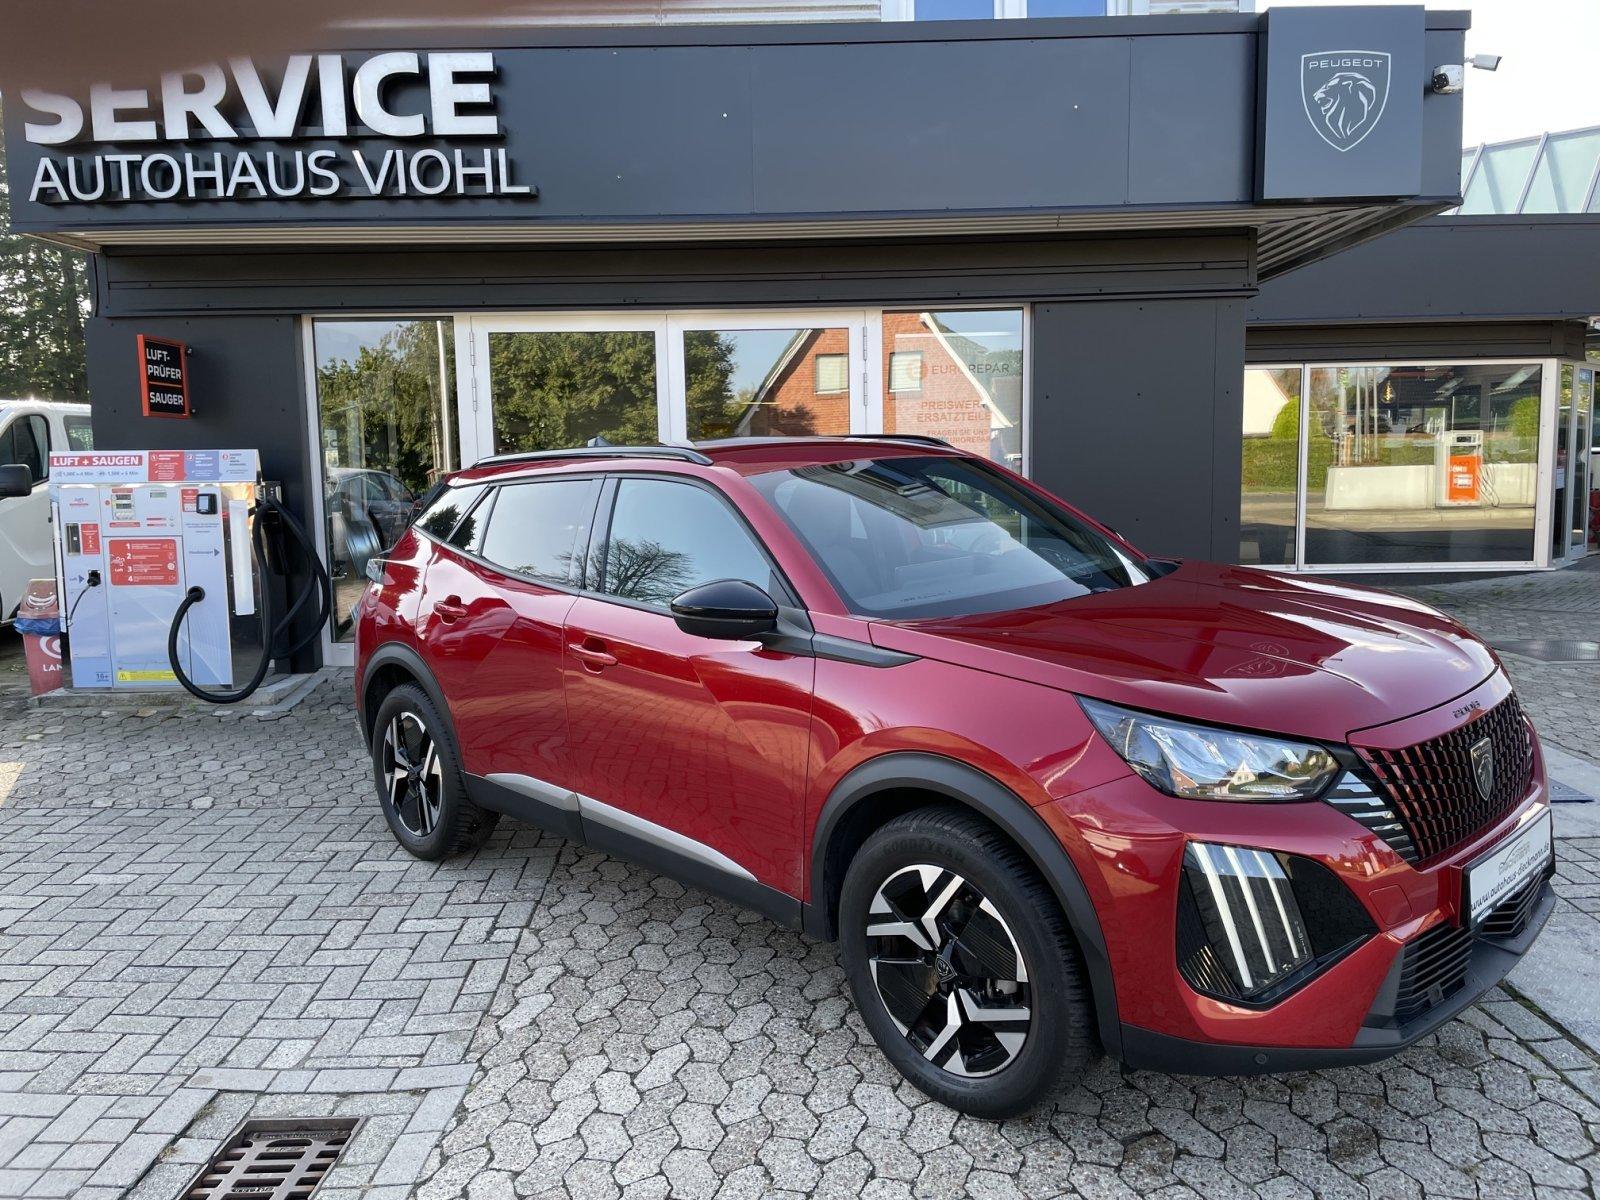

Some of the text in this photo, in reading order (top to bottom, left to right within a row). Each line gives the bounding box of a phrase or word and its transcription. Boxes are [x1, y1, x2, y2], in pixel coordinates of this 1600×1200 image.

[1309, 59, 1383, 69] PEUGEOT
[21, 51, 499, 145] SERVICE
[29, 148, 531, 201] AUTOHAUS VIOHL
[146, 347, 171, 362] LUFT-
[147, 364, 182, 380] PRÜFER
[149, 391, 184, 406] SAUGER
[917, 412, 991, 422] ERSATZTEILE
[53, 457, 80, 467] LUFT
[92, 456, 139, 466] SAUGEN
